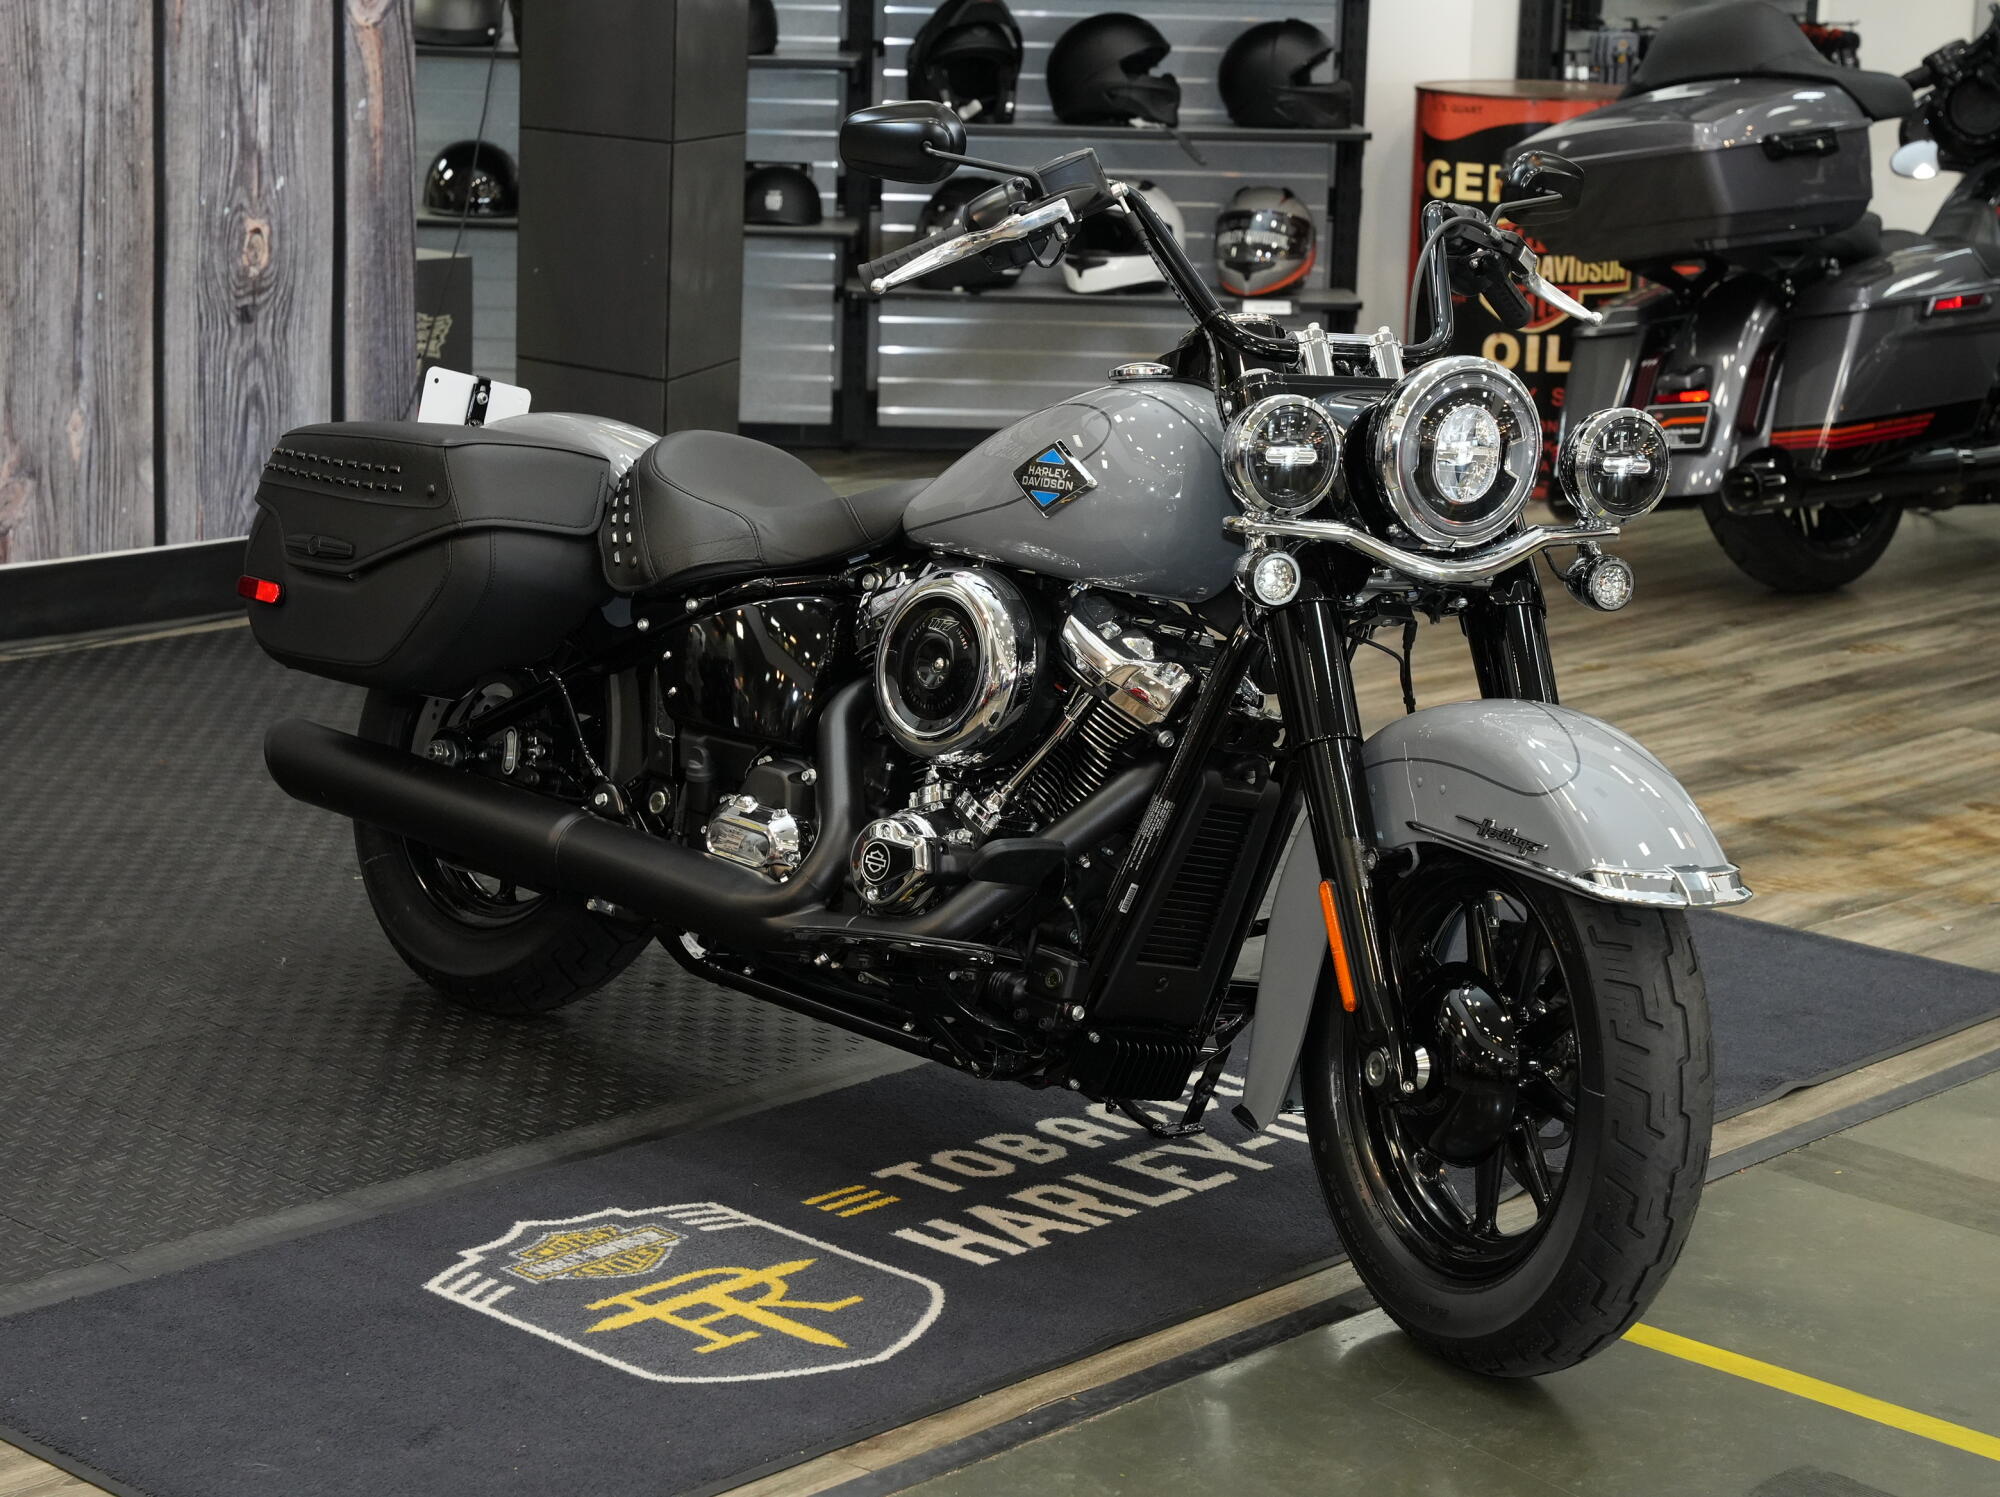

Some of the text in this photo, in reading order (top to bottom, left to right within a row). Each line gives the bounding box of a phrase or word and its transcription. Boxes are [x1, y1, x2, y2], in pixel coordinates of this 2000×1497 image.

[1536, 255, 1626, 283] AVIDSON
[1482, 332, 1572, 373] OIL
[1022, 475, 1074, 491] DAVIDSON
[1028, 465, 1071, 479] HARLEY-
